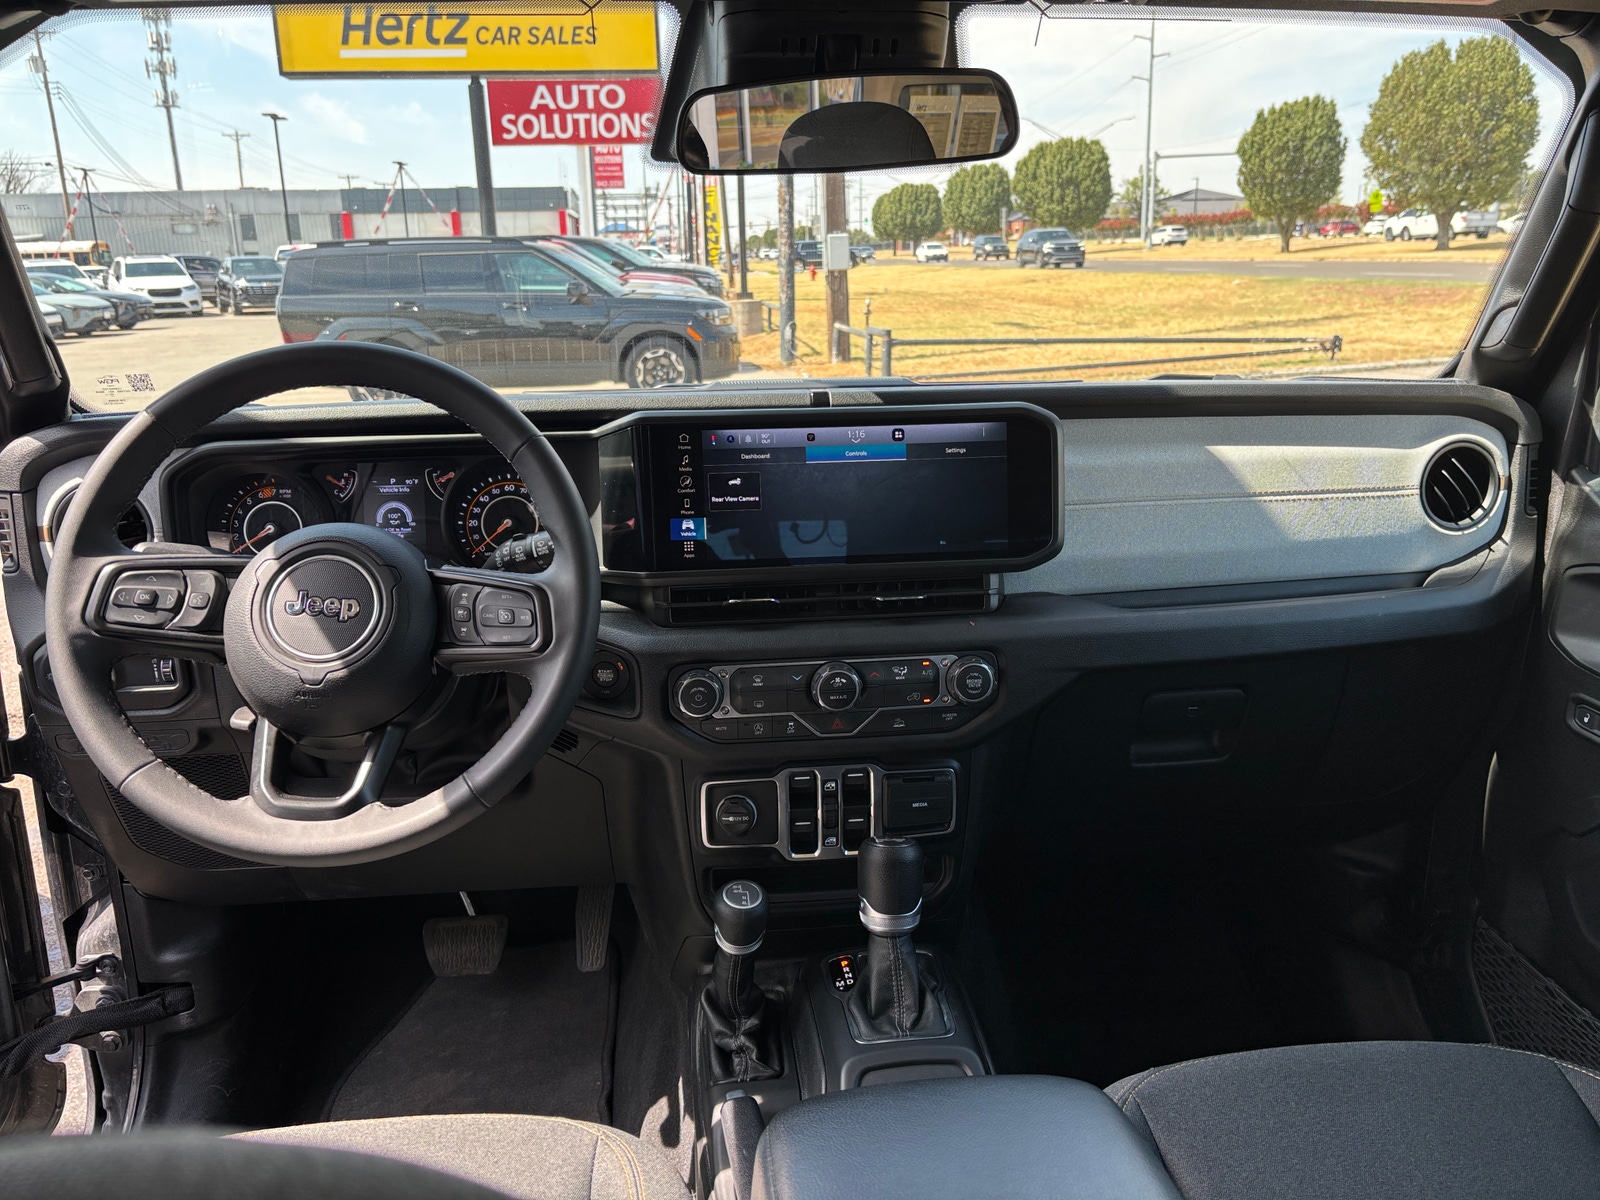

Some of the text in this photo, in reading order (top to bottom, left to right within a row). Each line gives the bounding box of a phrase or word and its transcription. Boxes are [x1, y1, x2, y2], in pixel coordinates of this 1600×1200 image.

[341, 4, 598, 46] Hertz CAR SALES
[529, 84, 625, 110] AUTO
[847, 430, 866, 439] 1:16
[258, 491, 264, 499] 6
[246, 497, 252, 505] 5
[233, 520, 239, 528] 3
[233, 533, 239, 541] 2
[285, 590, 360, 622] Jeep
